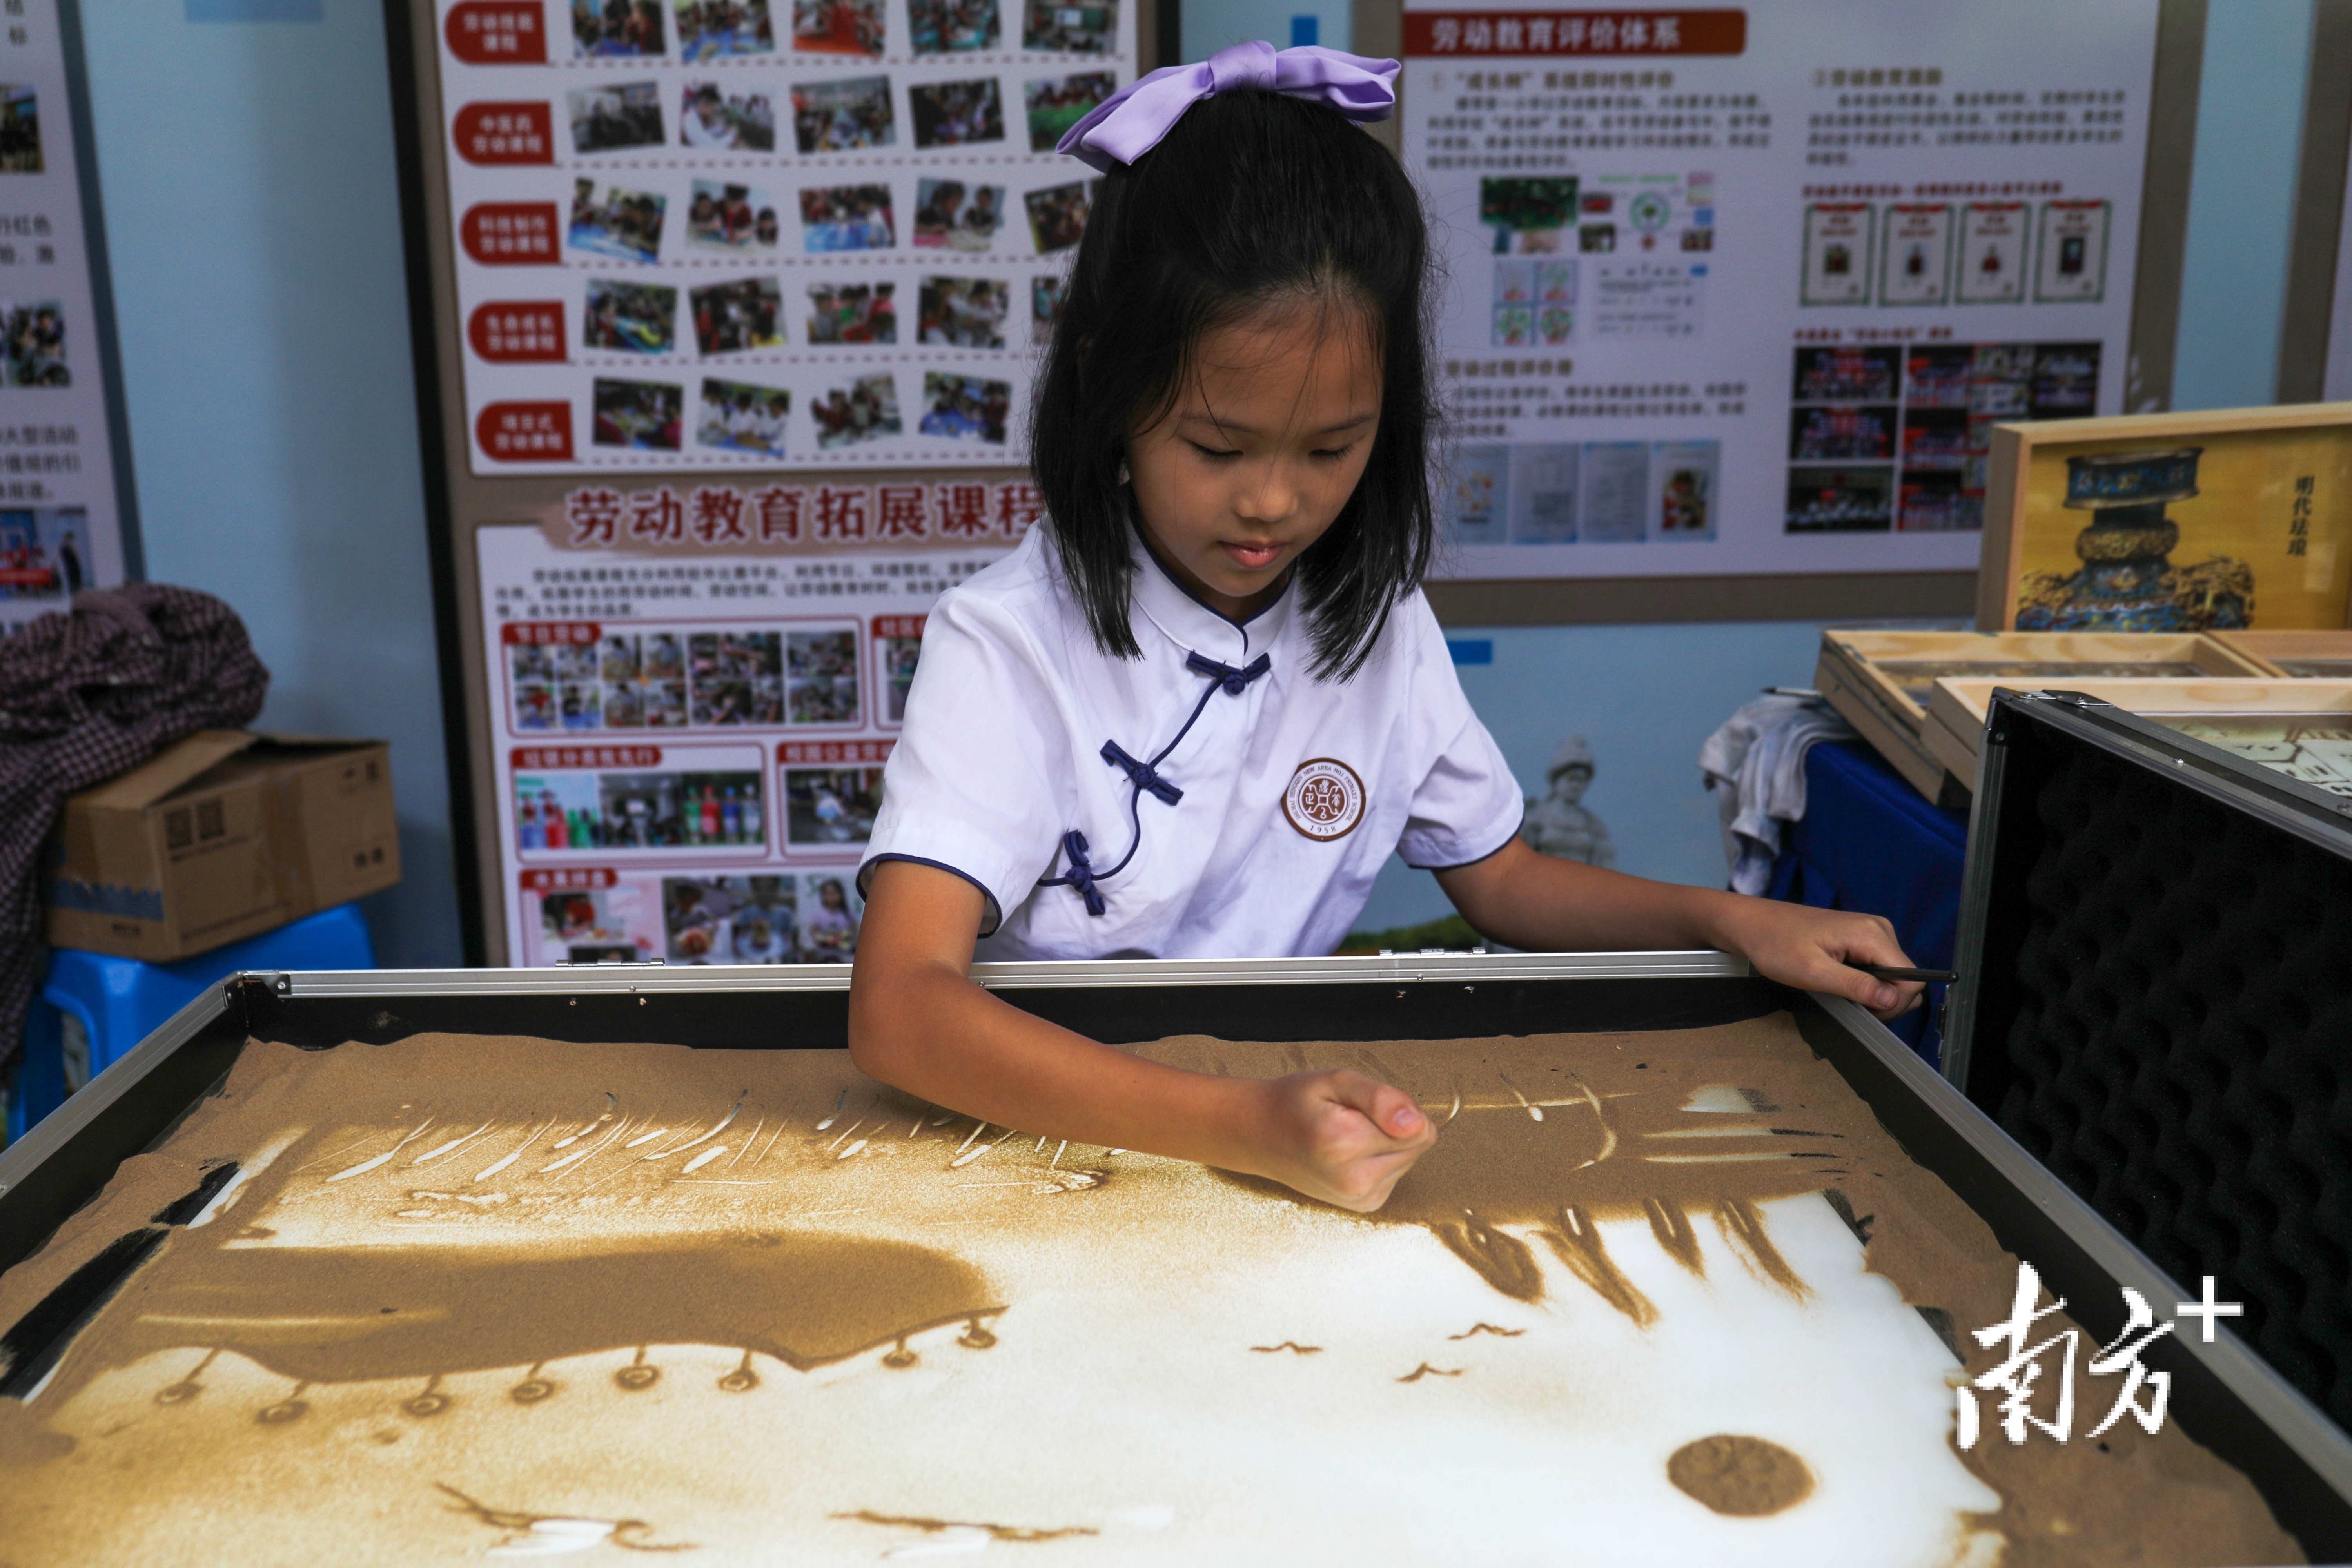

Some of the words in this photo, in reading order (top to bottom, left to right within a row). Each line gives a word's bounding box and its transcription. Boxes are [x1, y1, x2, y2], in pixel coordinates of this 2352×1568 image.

[1432, 17, 1681, 51] 劳动教育评价体系
[483, 34, 518, 53] 课程
[473, 136, 542, 154] 劳动课程
[480, 235, 549, 253] 劳动课程
[488, 334, 556, 352] 劳动课程
[495, 434, 563, 451] 劳动课程
[568, 484, 1045, 544] 劳动教育拓展课程
[2287, 475, 2314, 556] 明代珐琅
[516, 626, 592, 643] 节日劳动
[880, 617, 923, 637] 社区
[1303, 766, 1314, 776] NEW
[1345, 775, 1357, 800] PRIMARY
[1310, 824, 1336, 834] 1958
